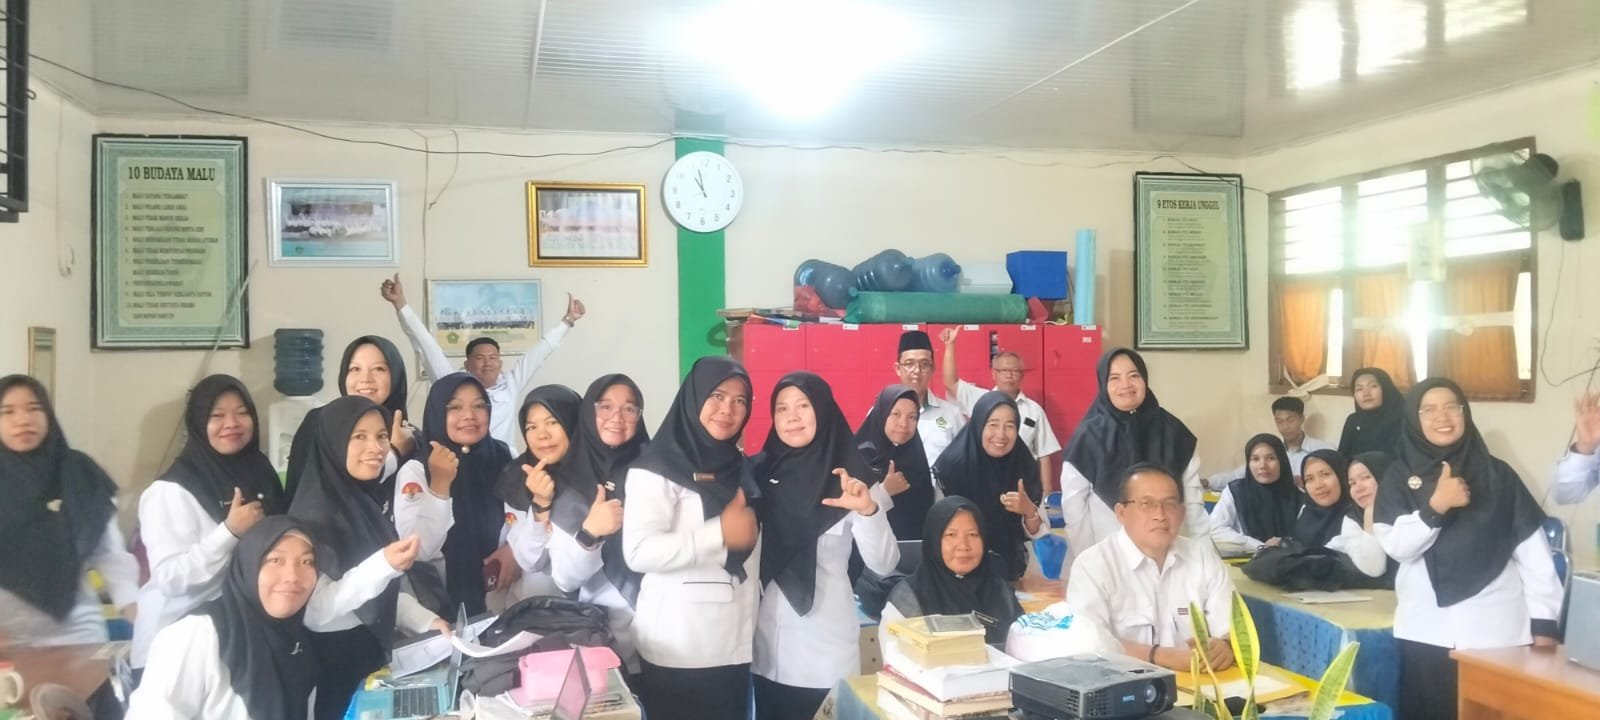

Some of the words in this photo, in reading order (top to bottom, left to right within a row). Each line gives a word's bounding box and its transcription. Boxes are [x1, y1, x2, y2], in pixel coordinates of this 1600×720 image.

[128, 166, 140, 180] 10
[143, 166, 184, 180] BUDAYA
[187, 167, 216, 181] MALU
